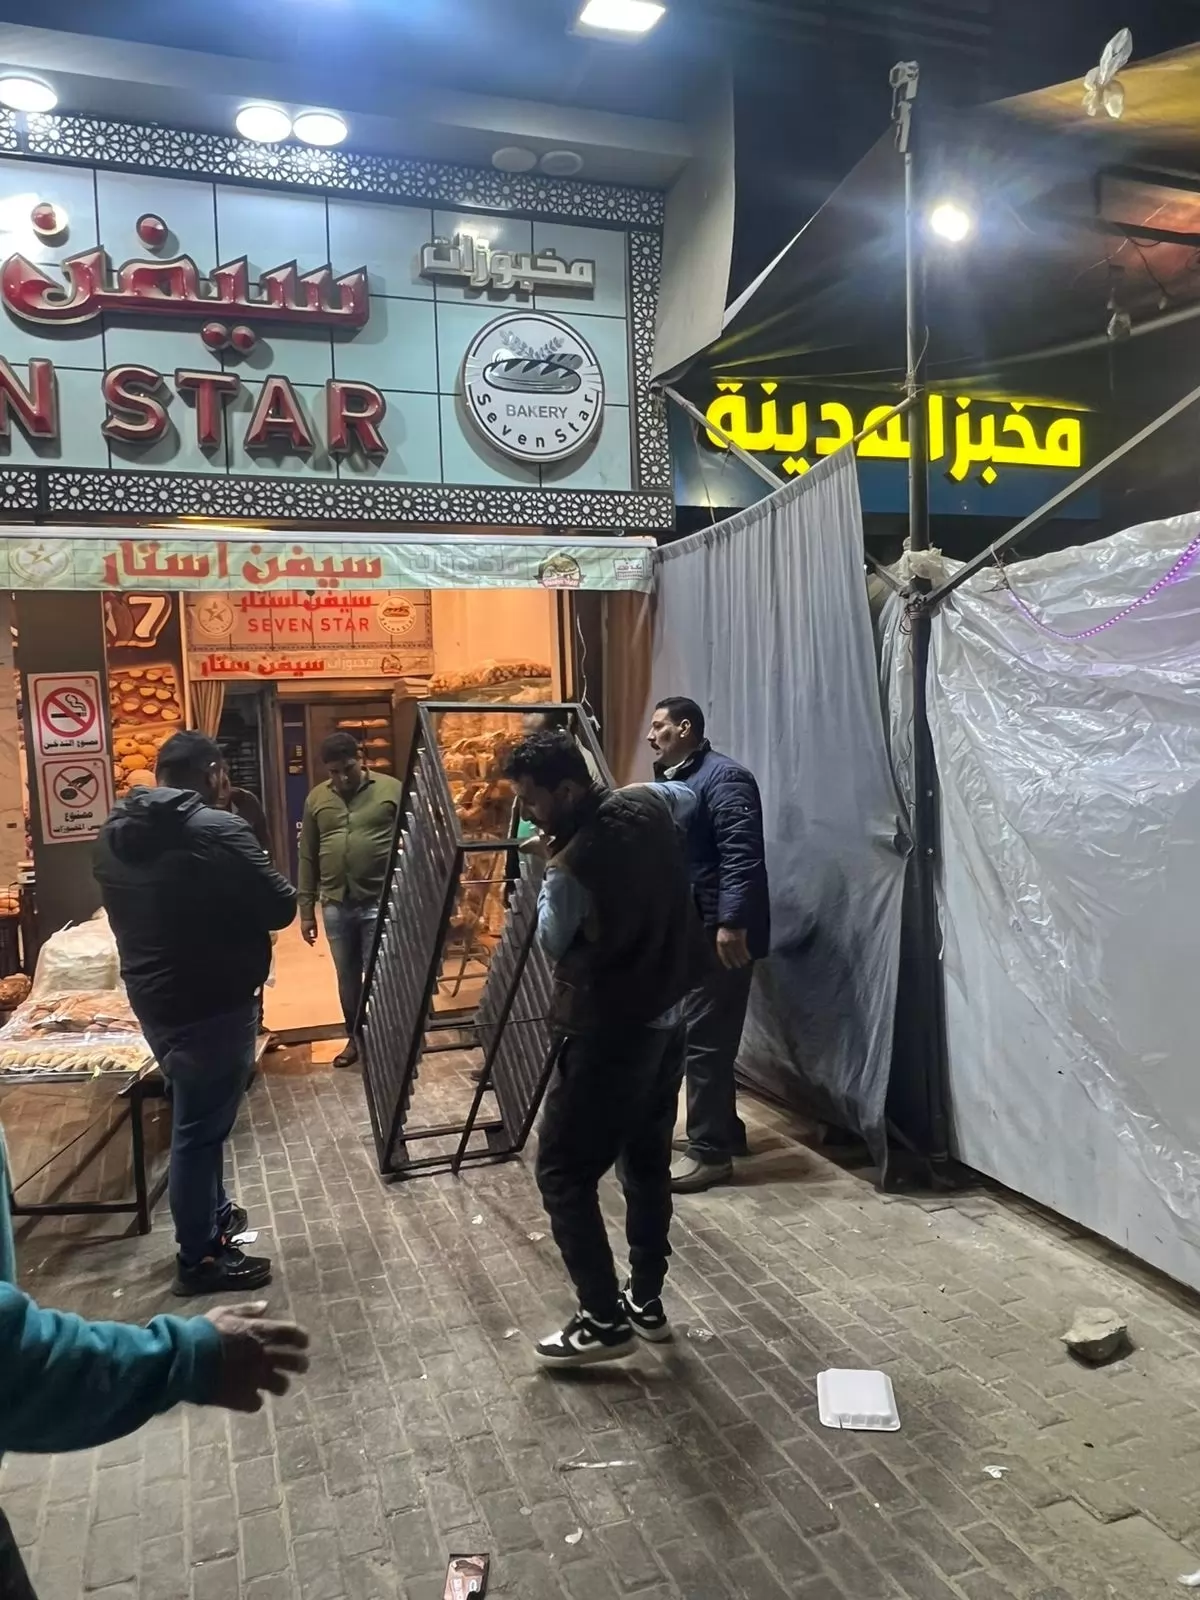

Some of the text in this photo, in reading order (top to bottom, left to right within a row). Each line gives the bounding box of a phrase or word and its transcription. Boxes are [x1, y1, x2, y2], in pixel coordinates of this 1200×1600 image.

[2, 202, 369, 353] سيفن
[421, 233, 595, 291] مخبوزات
[103, 363, 388, 456] STAR
[477, 393, 594, 448] Seven Star
[506, 404, 568, 419] BAKERY
[706, 382, 1081, 484] مخبز امدينة
[102, 540, 229, 587] استار
[242, 545, 381, 588] سيفن
[247, 617, 314, 633] SEVEN
[320, 617, 370, 632] STAR
[201, 654, 250, 677] ستار
[257, 655, 325, 676] سيفن
